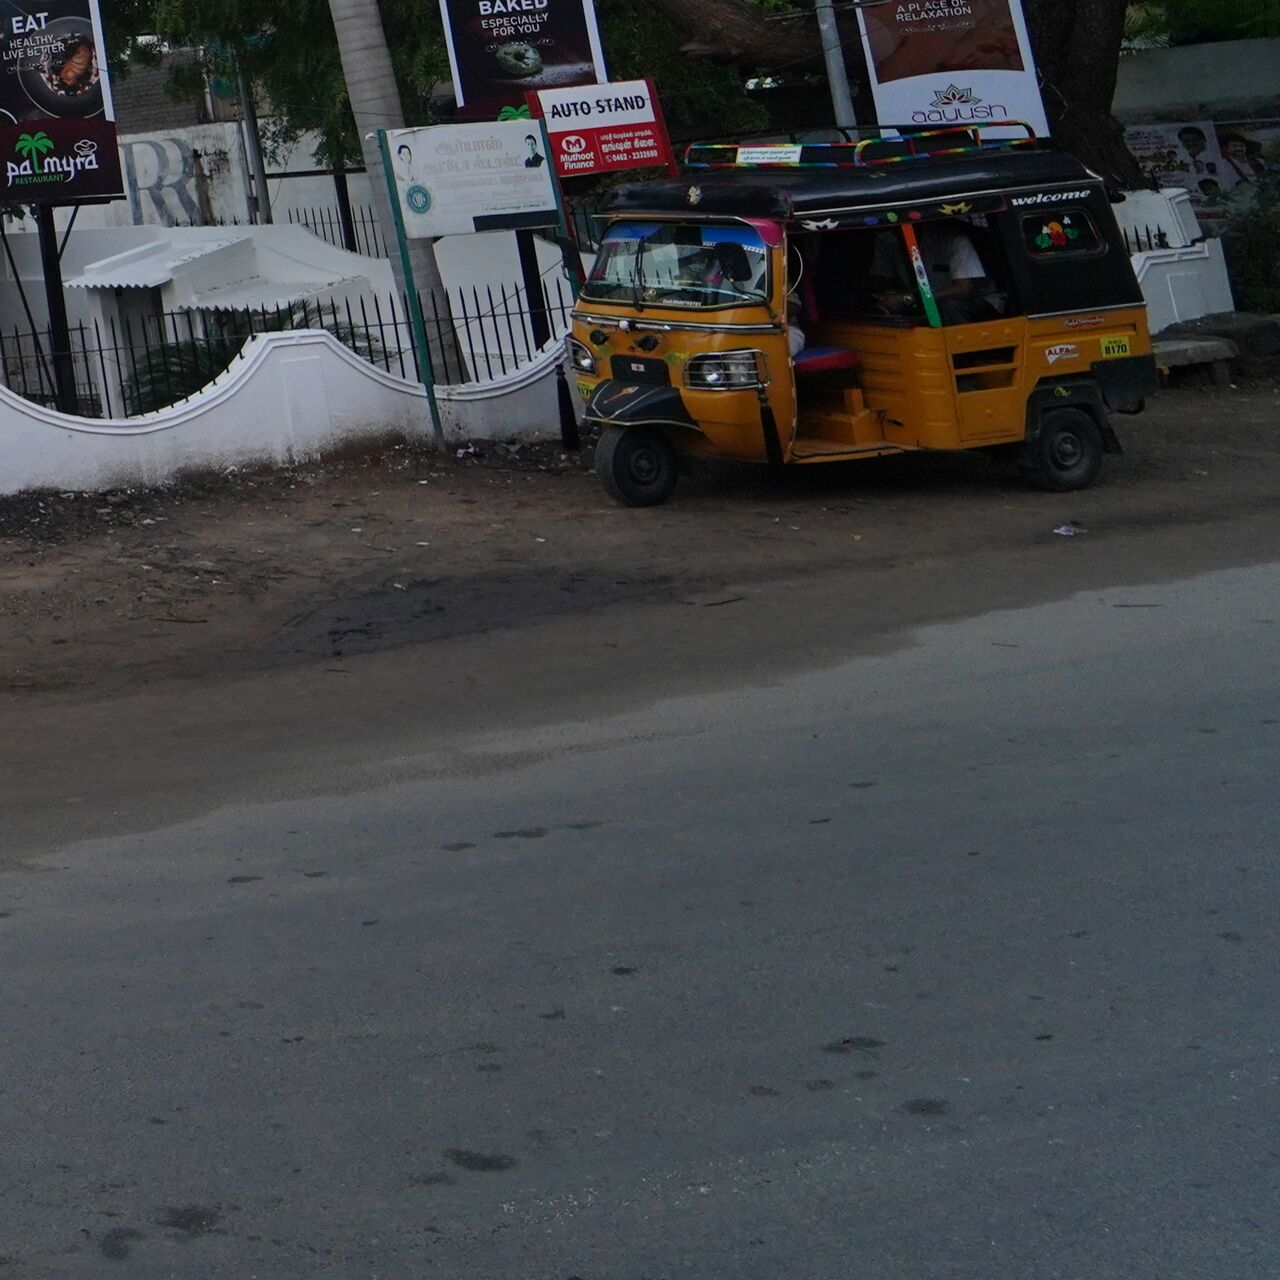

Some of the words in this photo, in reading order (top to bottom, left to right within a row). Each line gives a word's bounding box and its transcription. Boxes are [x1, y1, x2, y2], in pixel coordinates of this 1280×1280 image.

[896, 6, 972, 22] RELAXATION
[897, 4, 905, 14] A
[908, 0, 947, 11] PLACE
[11, 12, 49, 34] EAT
[481, 12, 549, 29] ESPECIALLY
[493, 27, 515, 37] FOR
[516, 23, 540, 34] YOU
[3, 48, 25, 60] LIVE
[27, 42, 66, 57] BETTER
[551, 101, 592, 119] AUTO
[596, 95, 646, 114] STAND
[912, 103, 1008, 124] aayush
[6, 143, 99, 187] palmyra
[560, 151, 594, 163] Muthoot
[564, 160, 595, 170] Finance
[15, 174, 64, 185] RESTAURANT
[1011, 190, 1091, 206] welcome
[1047, 346, 1072, 356] ALFA
[1105, 344, 1127, 354] 8170
